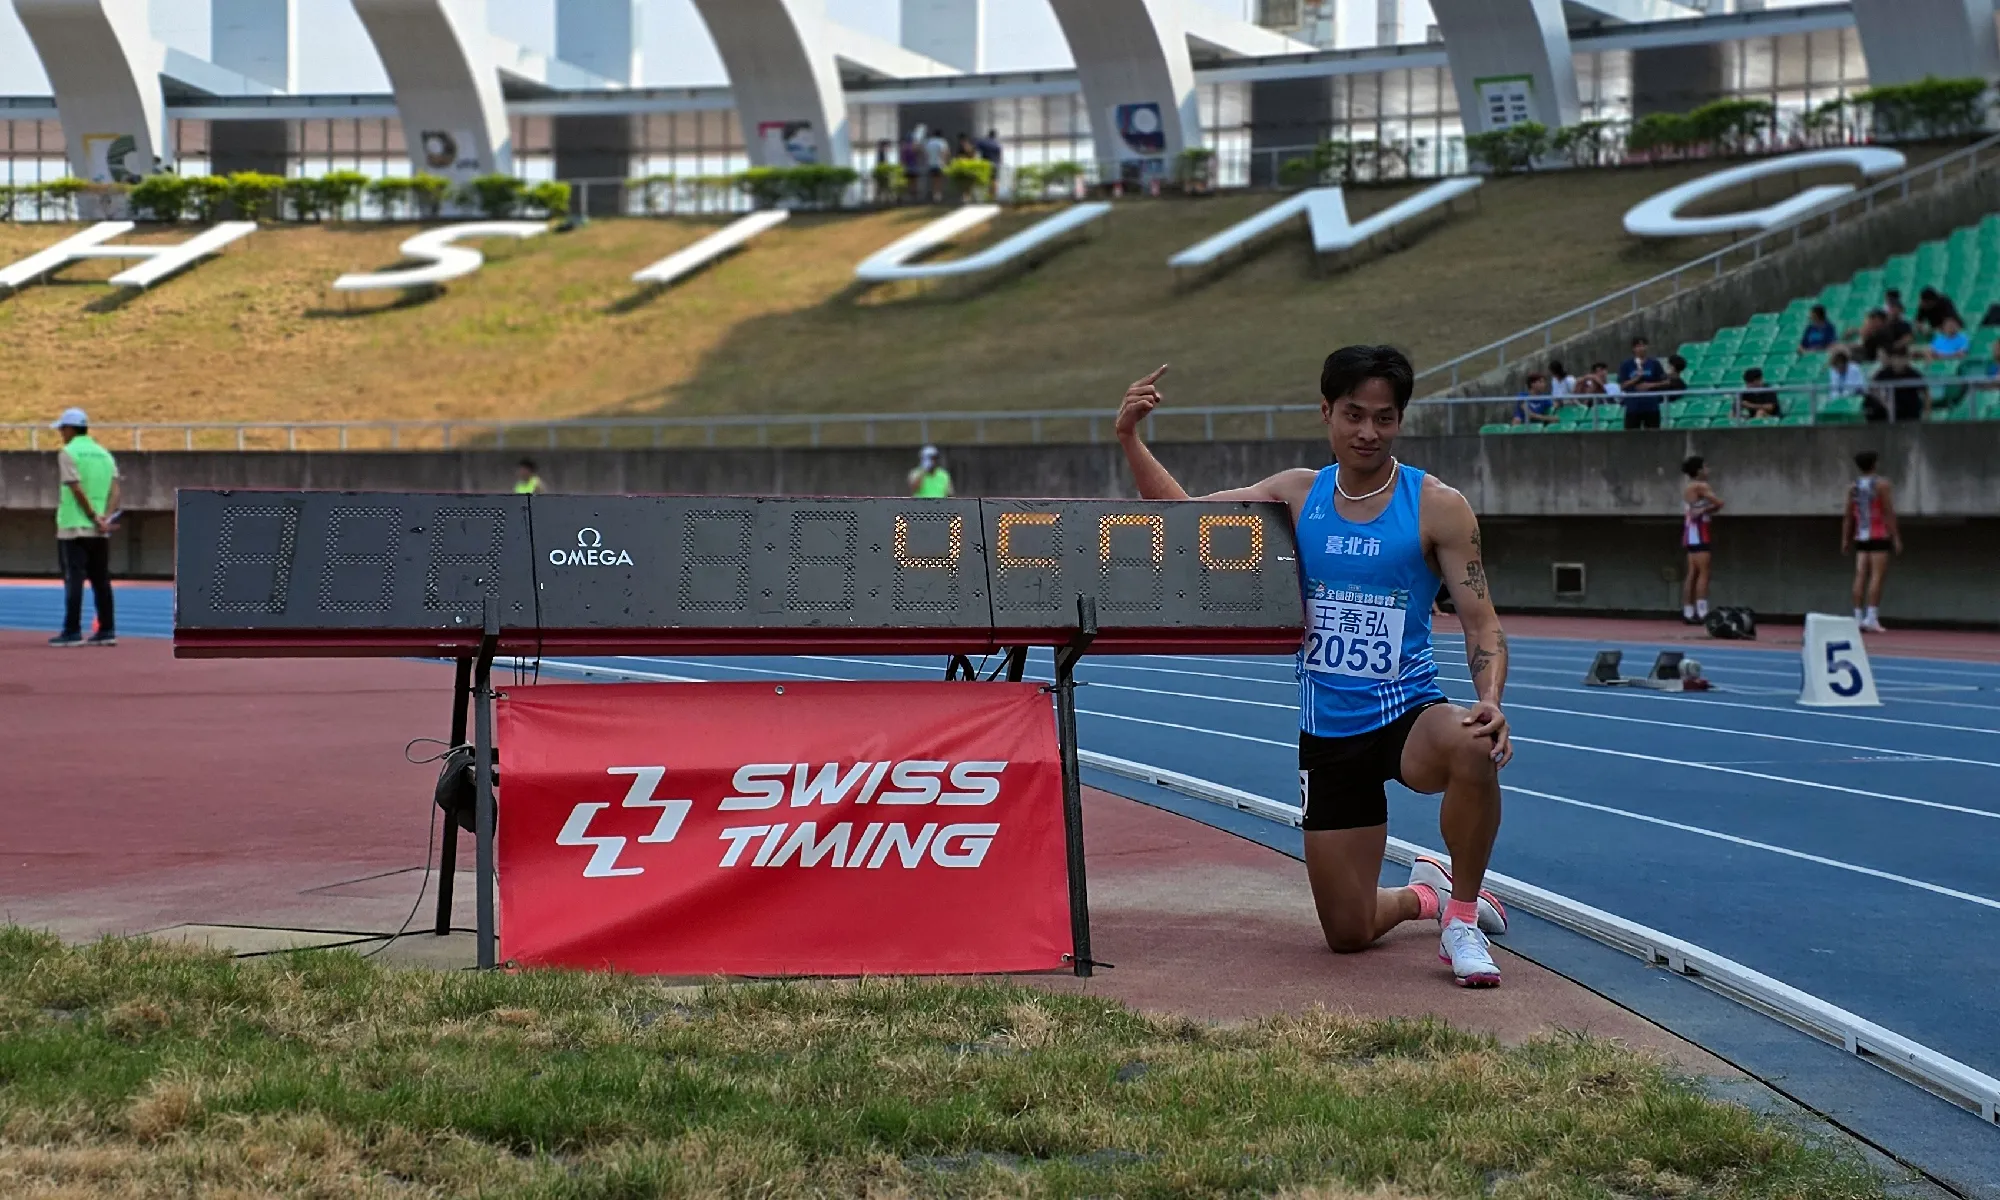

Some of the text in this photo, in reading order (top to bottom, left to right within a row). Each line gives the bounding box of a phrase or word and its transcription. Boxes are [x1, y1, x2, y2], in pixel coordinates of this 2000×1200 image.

[549, 549, 634, 566] OMEGA
[1325, 535, 1382, 557] 臺北市
[1313, 605, 1390, 639] 王喬弘
[1306, 632, 1392, 674] 2053
[1826, 641, 1864, 697] 5
[718, 760, 1008, 811] SWISS
[718, 822, 1001, 869] TIMING
